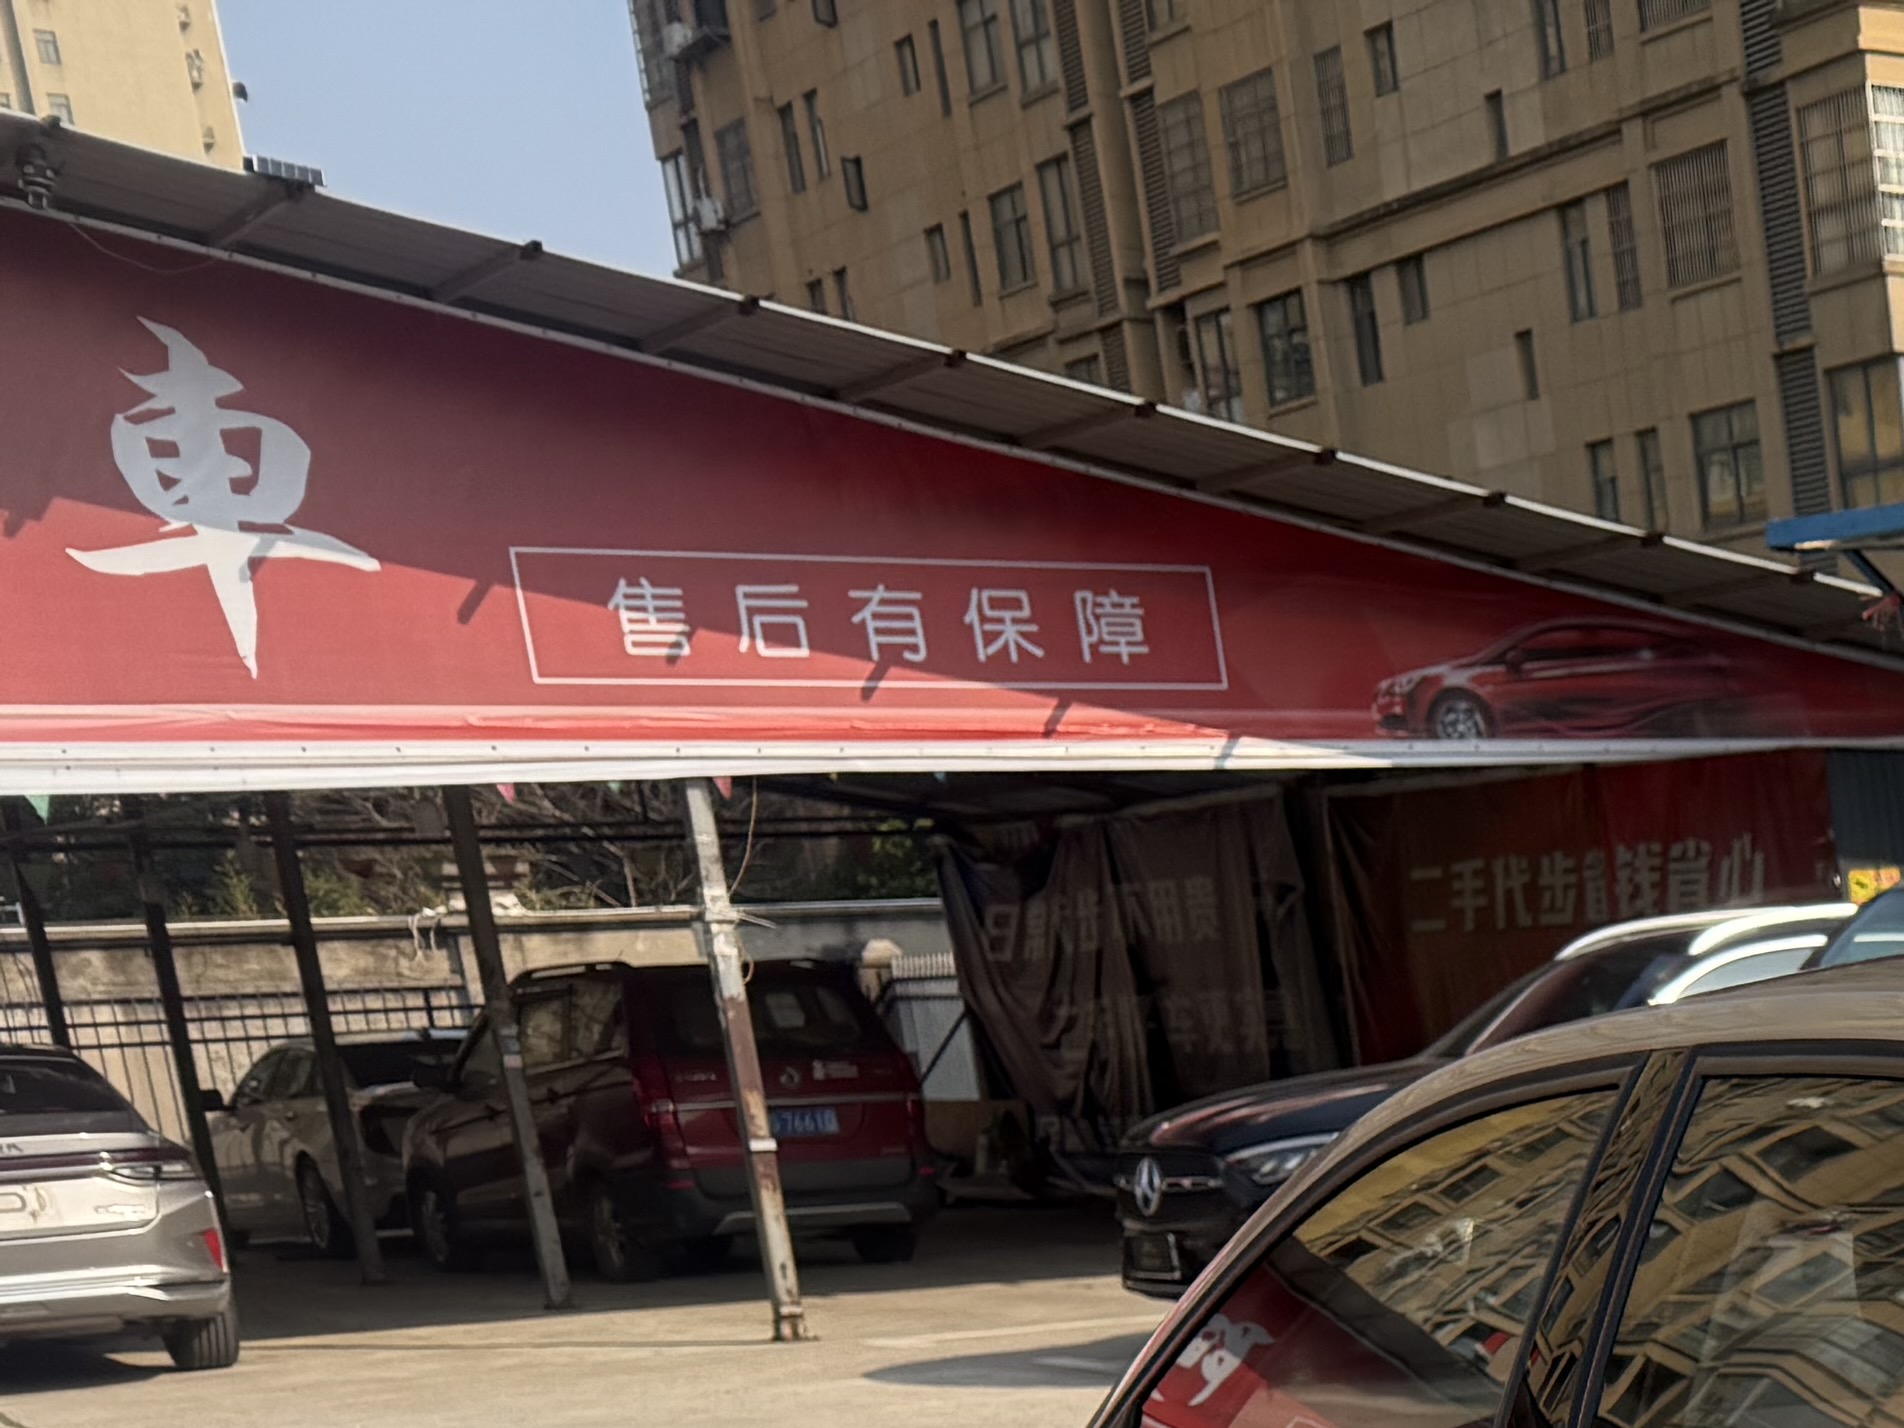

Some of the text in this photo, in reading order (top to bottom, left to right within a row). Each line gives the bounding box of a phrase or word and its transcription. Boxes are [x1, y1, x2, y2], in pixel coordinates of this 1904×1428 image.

[65, 315, 381, 679] 車
[607, 576, 1150, 667] 售后有保障
